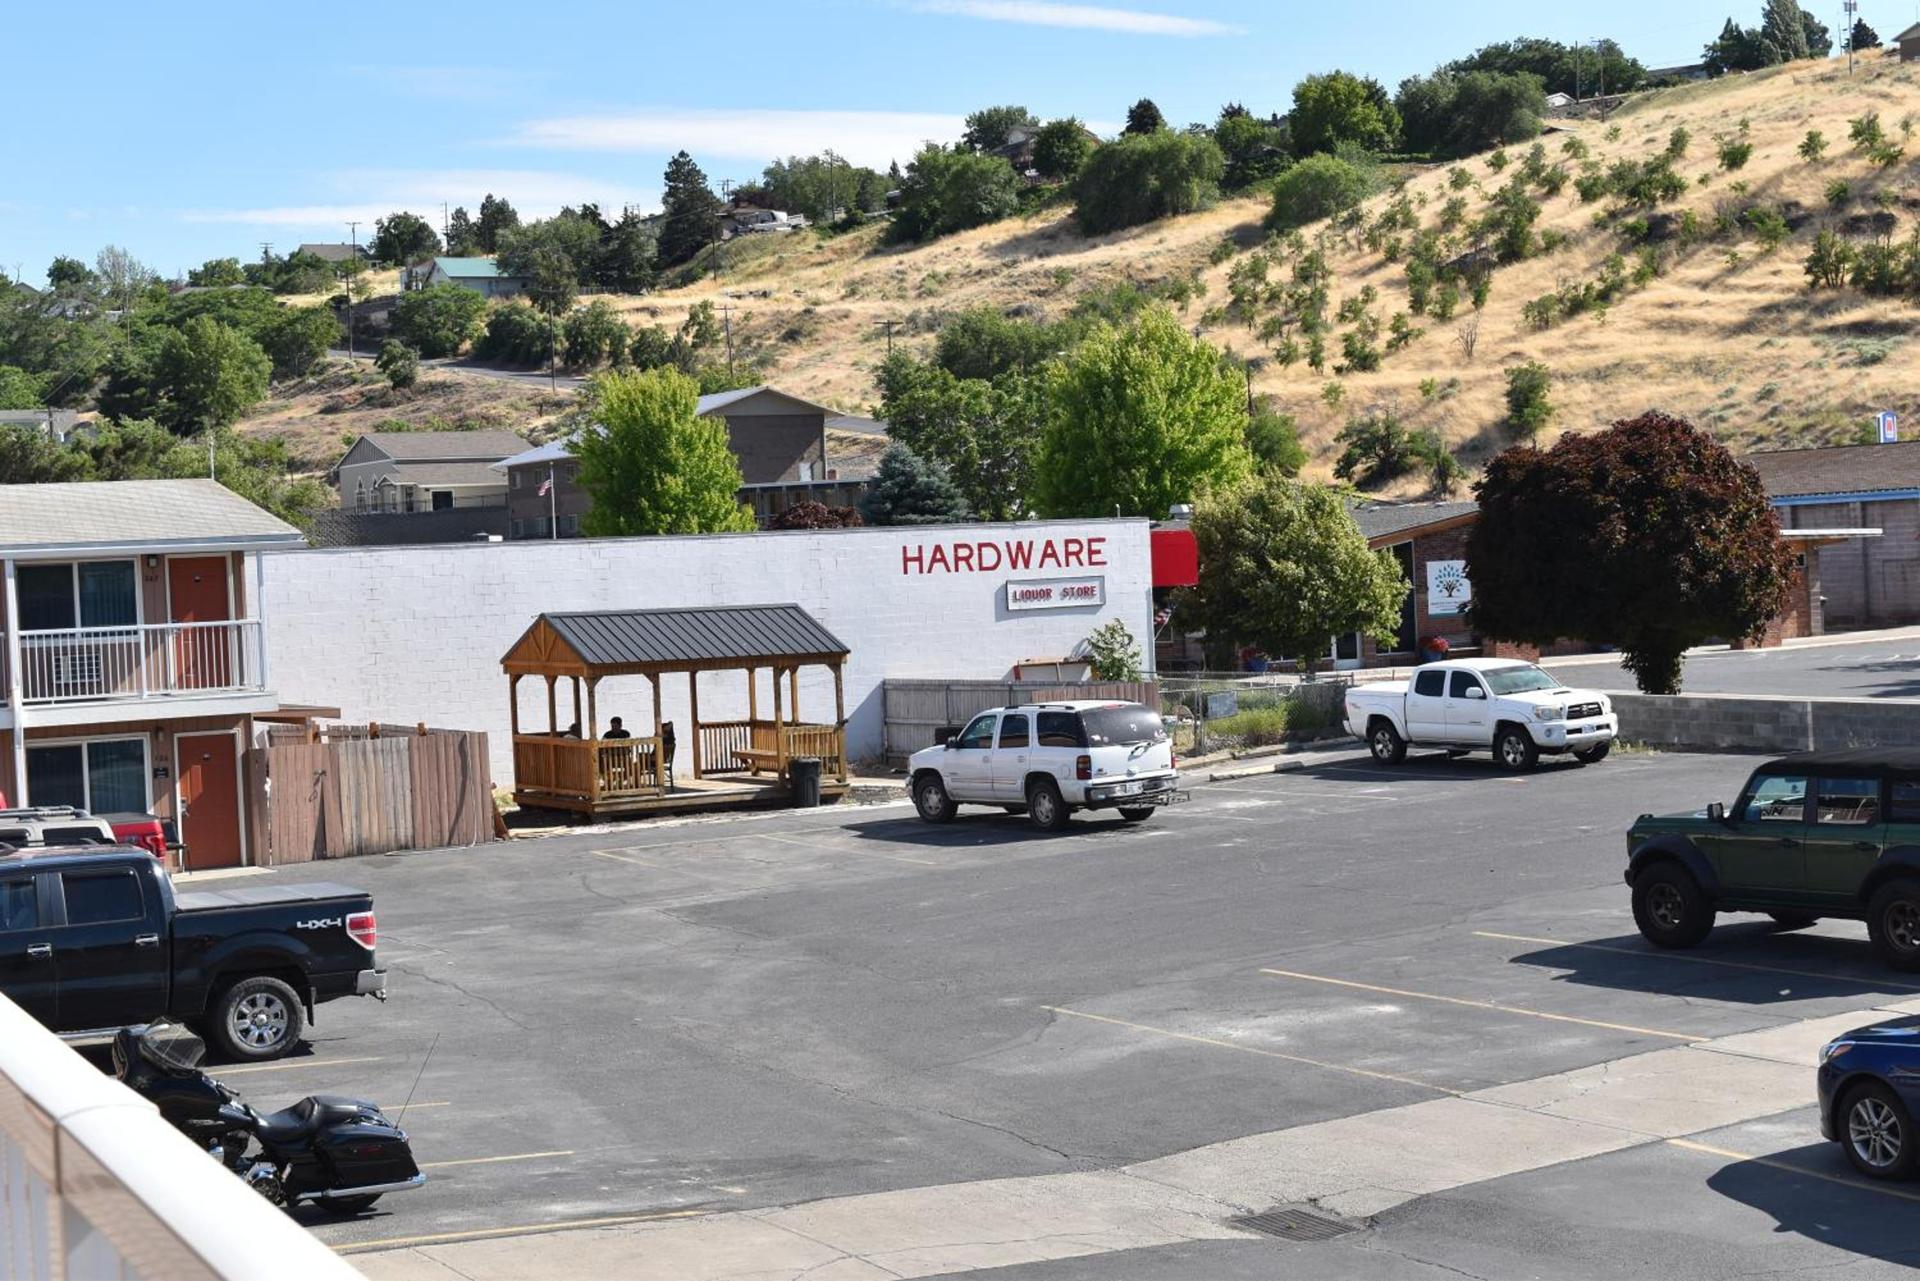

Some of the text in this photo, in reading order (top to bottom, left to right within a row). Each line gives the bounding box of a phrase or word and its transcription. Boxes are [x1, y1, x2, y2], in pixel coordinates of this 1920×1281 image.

[902, 537, 1107, 575] HARDWARE
[1013, 585, 1097, 601] LIQUOR STORE
